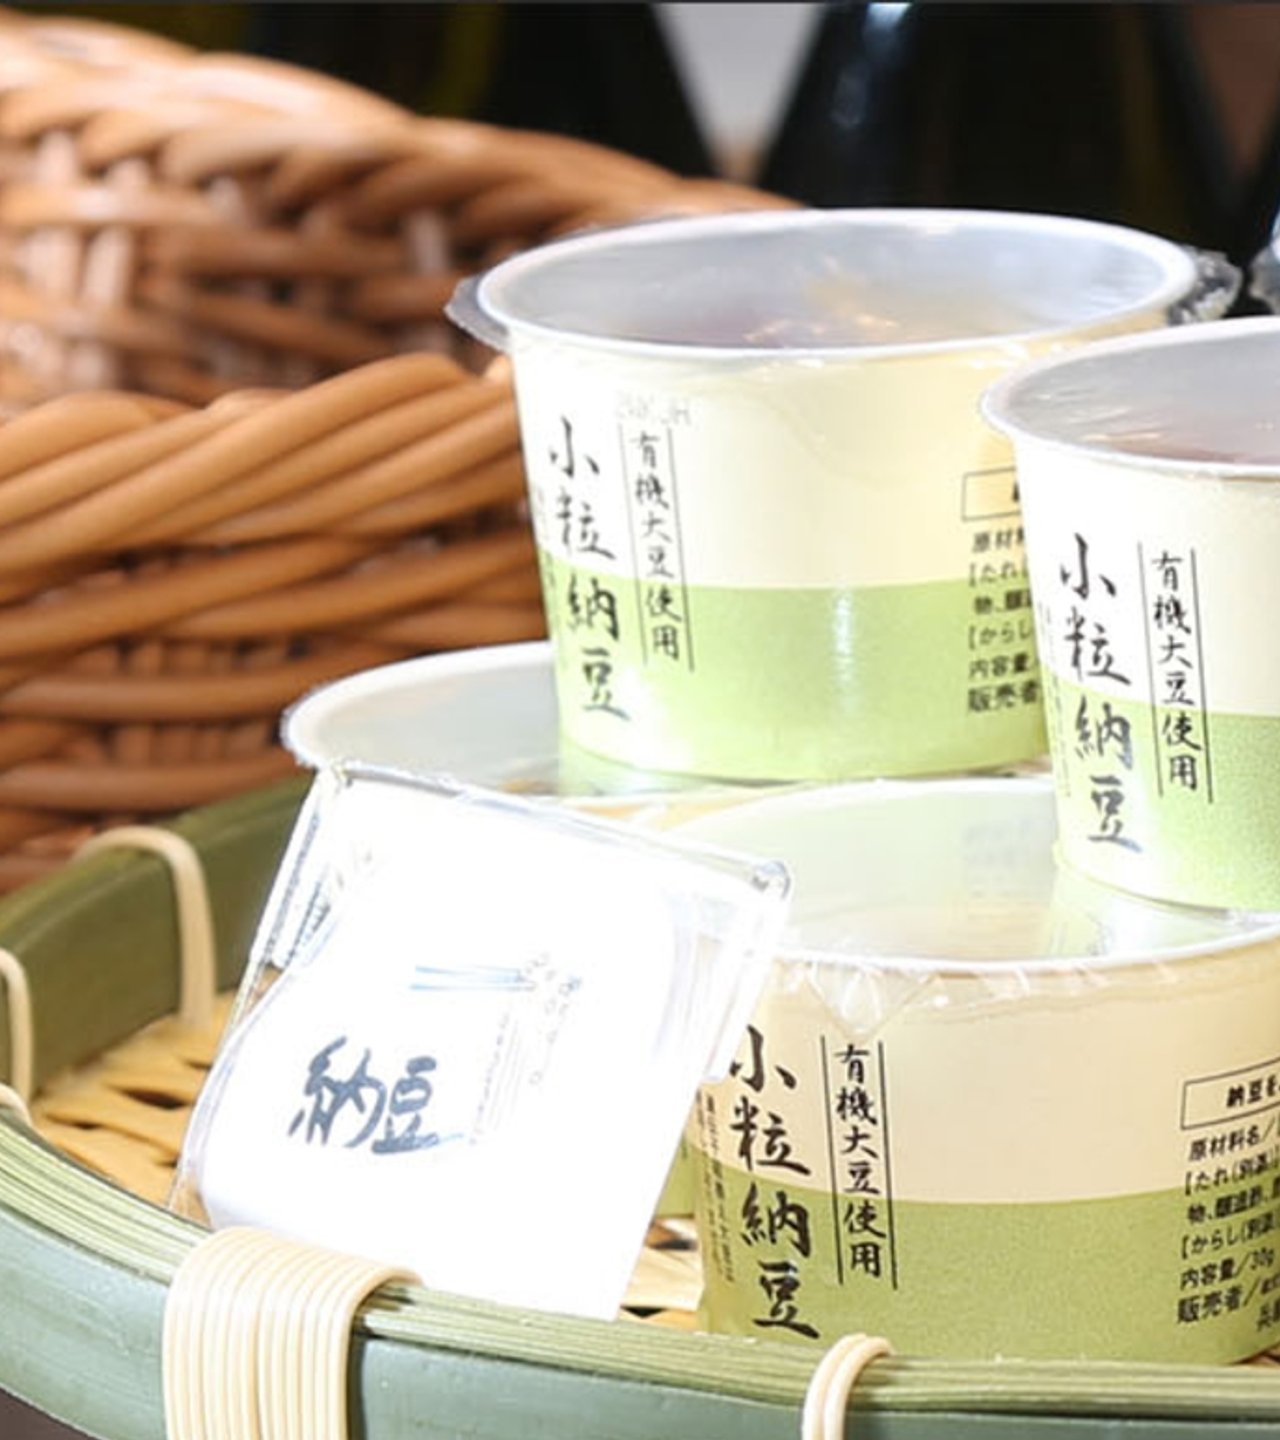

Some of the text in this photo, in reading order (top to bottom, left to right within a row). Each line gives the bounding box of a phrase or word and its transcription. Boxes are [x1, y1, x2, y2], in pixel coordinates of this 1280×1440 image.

[550, 416, 631, 721] 小粒納豆
[629, 431, 683, 661] 有機大豆使用
[1061, 533, 1143, 853] 小粒納豆
[1152, 551, 1202, 791] 有機大豆使用
[288, 1036, 441, 1155] 納豆
[729, 1024, 820, 1340] 小粒納豆
[834, 1044, 887, 1278] 有機大豆使用
